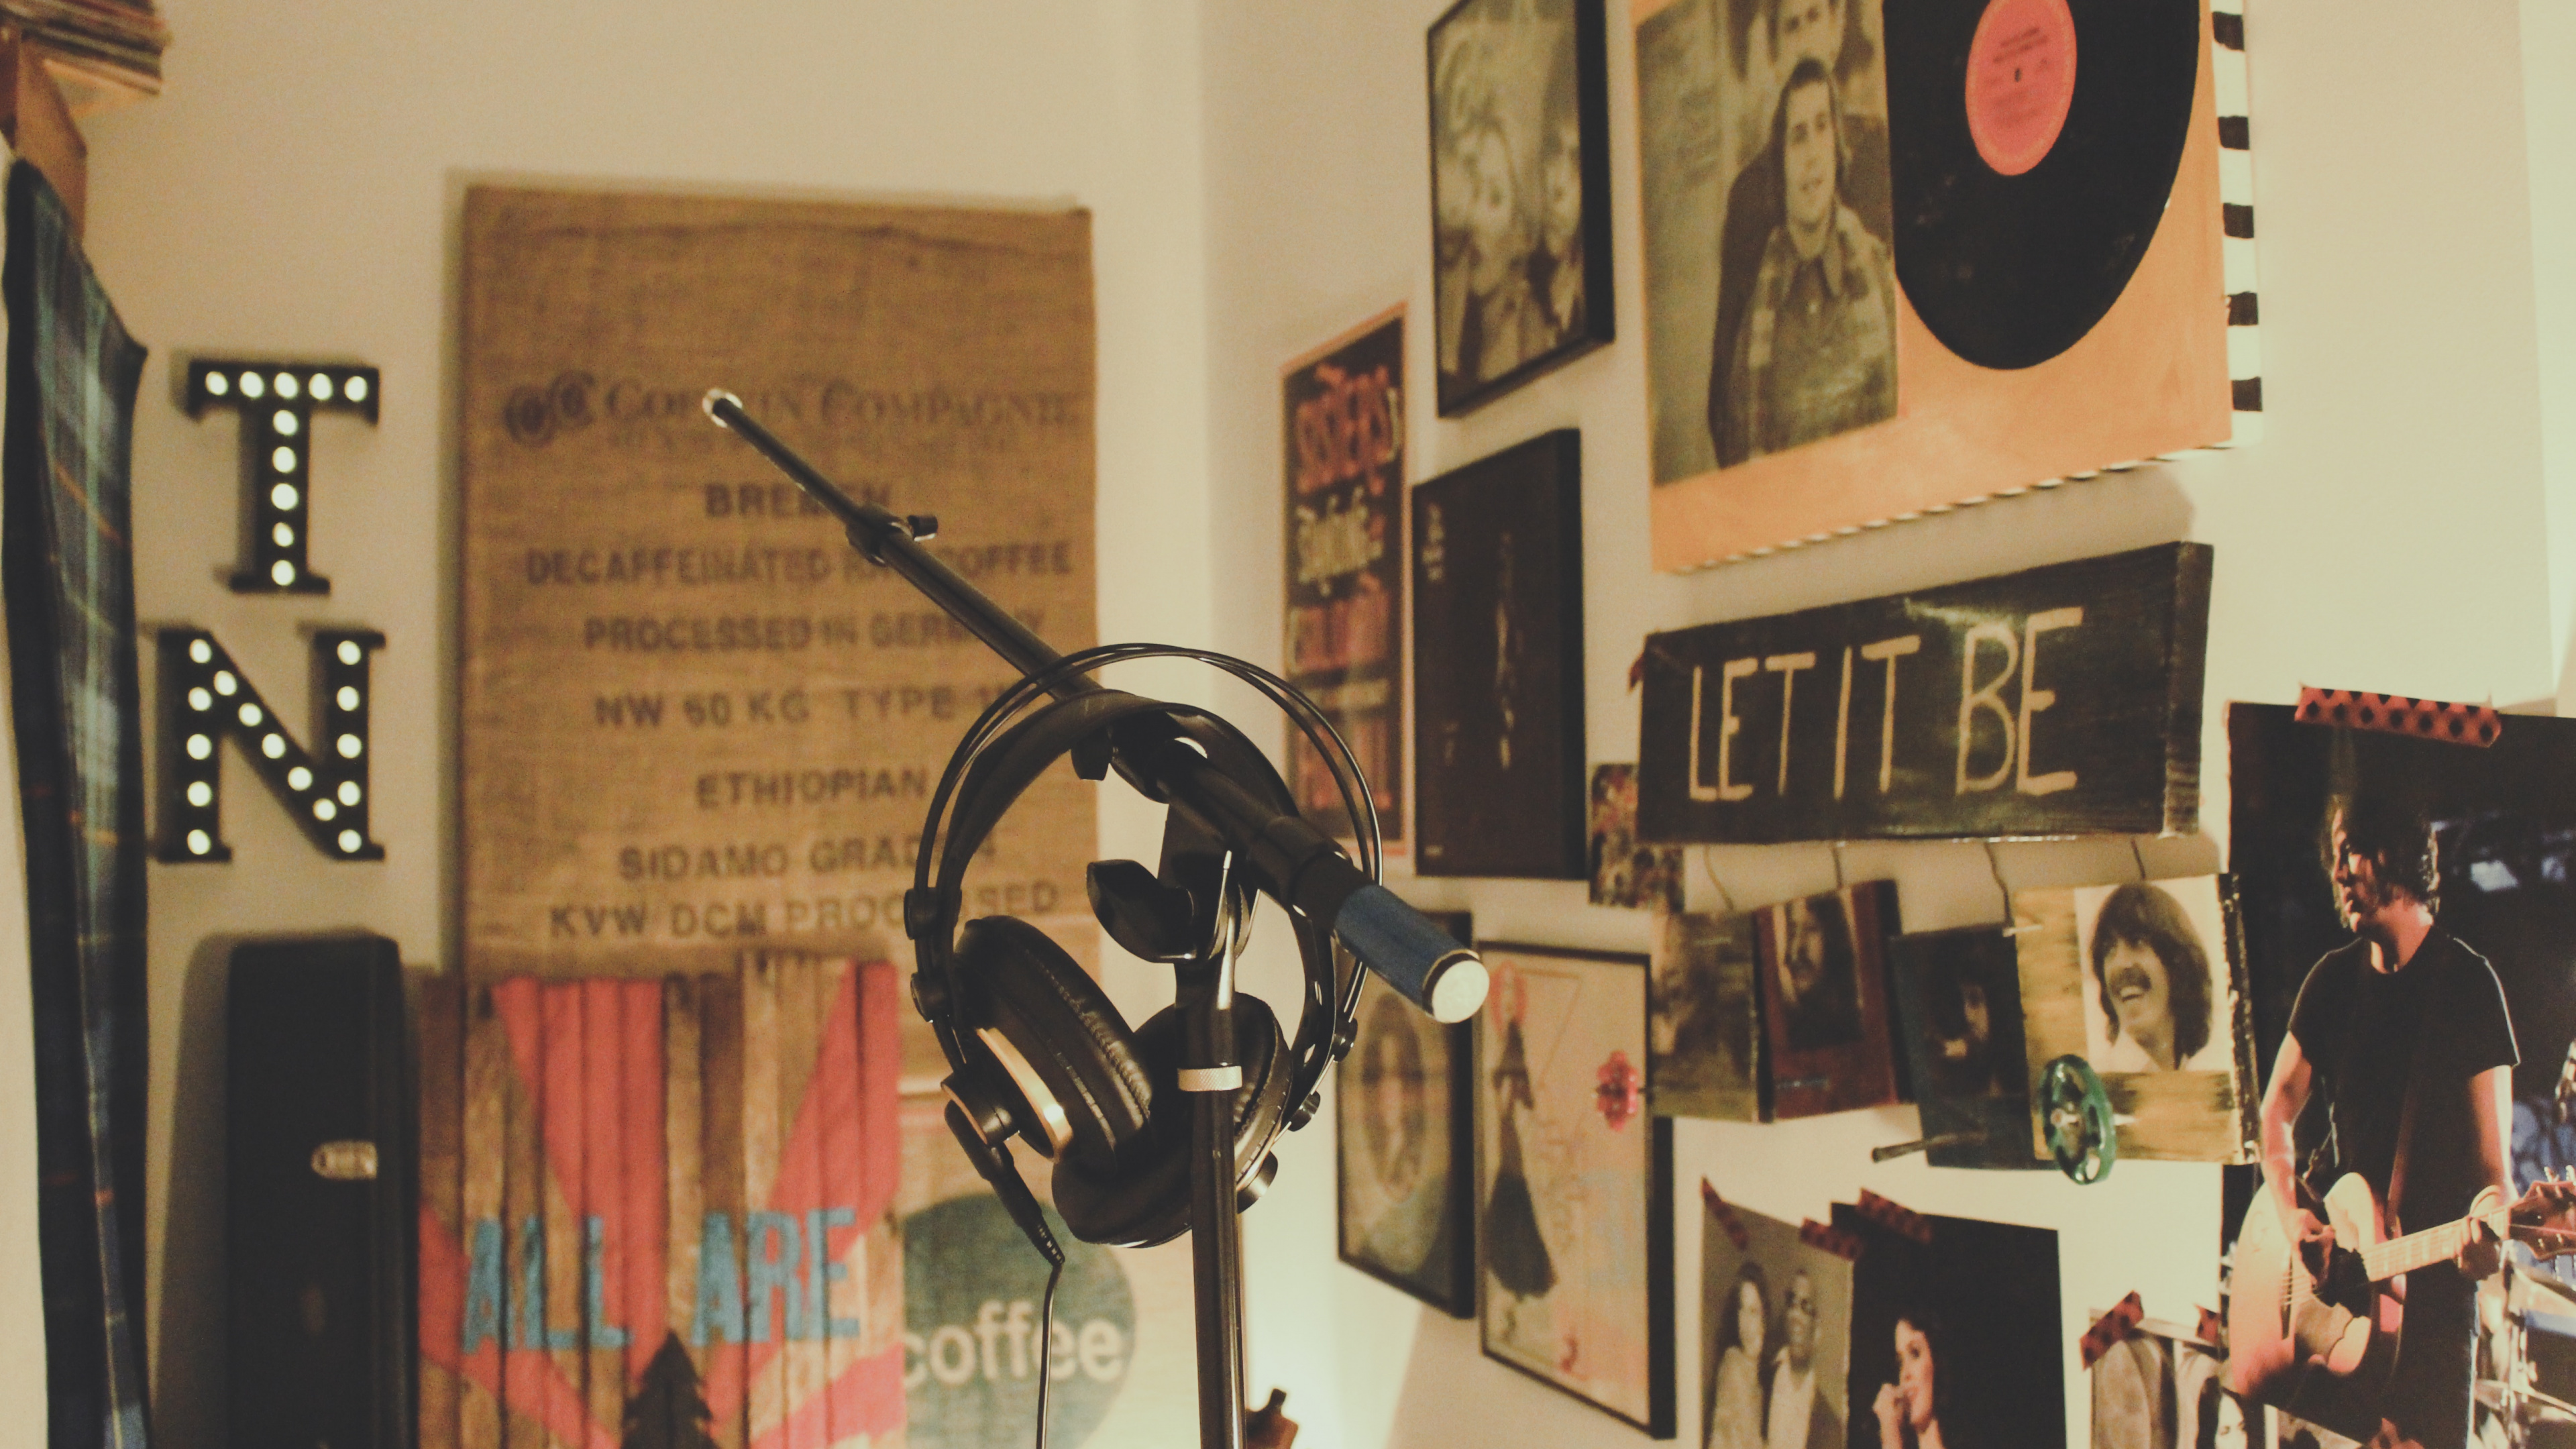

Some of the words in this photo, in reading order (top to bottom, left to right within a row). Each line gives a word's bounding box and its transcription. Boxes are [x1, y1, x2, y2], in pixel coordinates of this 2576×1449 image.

[187, 360, 380, 594] T
[525, 546, 832, 585] DECAFFEINATED
[584, 615, 812, 653] PROCESSED
[594, 691, 663, 729] NW
[746, 686, 810, 723] KG
[840, 684, 957, 722] TYPE
[1688, 651, 1817, 802] LET
[1833, 635, 1922, 800] IT
[1955, 606, 2084, 797] BE
[154, 628, 387, 865] N
[696, 767, 928, 809] ETHIOPIAN
[618, 843, 788, 882] SIDAMO
[549, 900, 649, 938] KVW
[669, 901, 767, 938] DCM
[784, 879, 1060, 934] PROCSED
[462, 1213, 631, 1356] ALL
[690, 1207, 861, 1347] ARE
